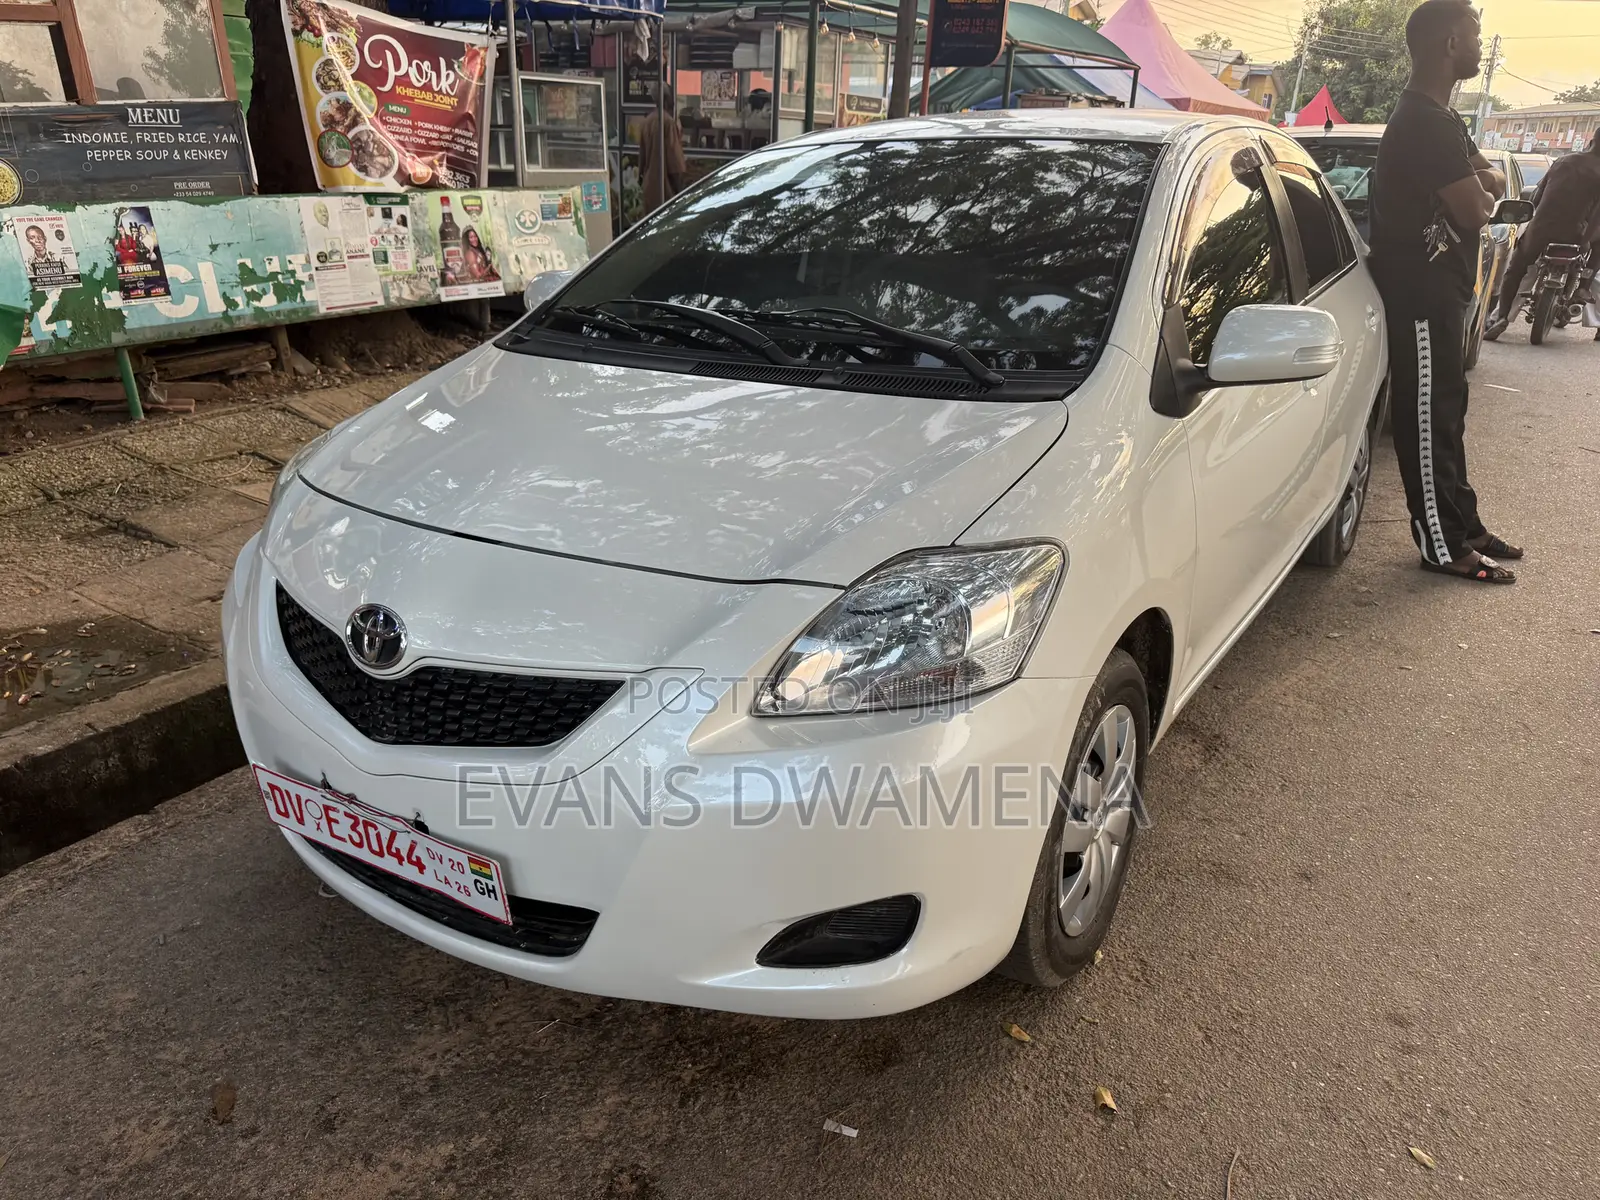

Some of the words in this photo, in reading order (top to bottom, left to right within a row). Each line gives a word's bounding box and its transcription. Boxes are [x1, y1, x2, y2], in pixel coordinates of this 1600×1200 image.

[363, 34, 460, 96] Pork
[395, 85, 433, 101] KHEBAB
[434, 93, 458, 106] JOINT
[388, 104, 406, 114] MENU
[127, 108, 181, 125] MENU
[386, 115, 412, 126] CHICKEN
[418, 121, 434, 130] PORK
[63, 132, 133, 145] INDOMIE,
[136, 132, 175, 143] FRIED
[178, 132, 211, 145] RICE,
[214, 132, 243, 145] YAM,
[410, 136, 427, 145] FOWL
[86, 149, 132, 161] PEPPER
[136, 150, 169, 160] SOUP
[173, 150, 181, 160] &
[184, 149, 228, 160] KENKEY
[454, 171, 471, 183] 363
[173, 181, 187, 189] PRE
[188, 181, 211, 189] ORDER
[36, 267, 63, 276] ASIMENU
[124, 264, 152, 273] FOREVER
[267, 781, 305, 826] DV
[322, 803, 427, 875] E3044
[425, 847, 444, 866] DV
[449, 858, 466, 875] 20
[434, 869, 453, 889] LA
[455, 883, 472, 898] 26
[473, 878, 499, 901] GH
